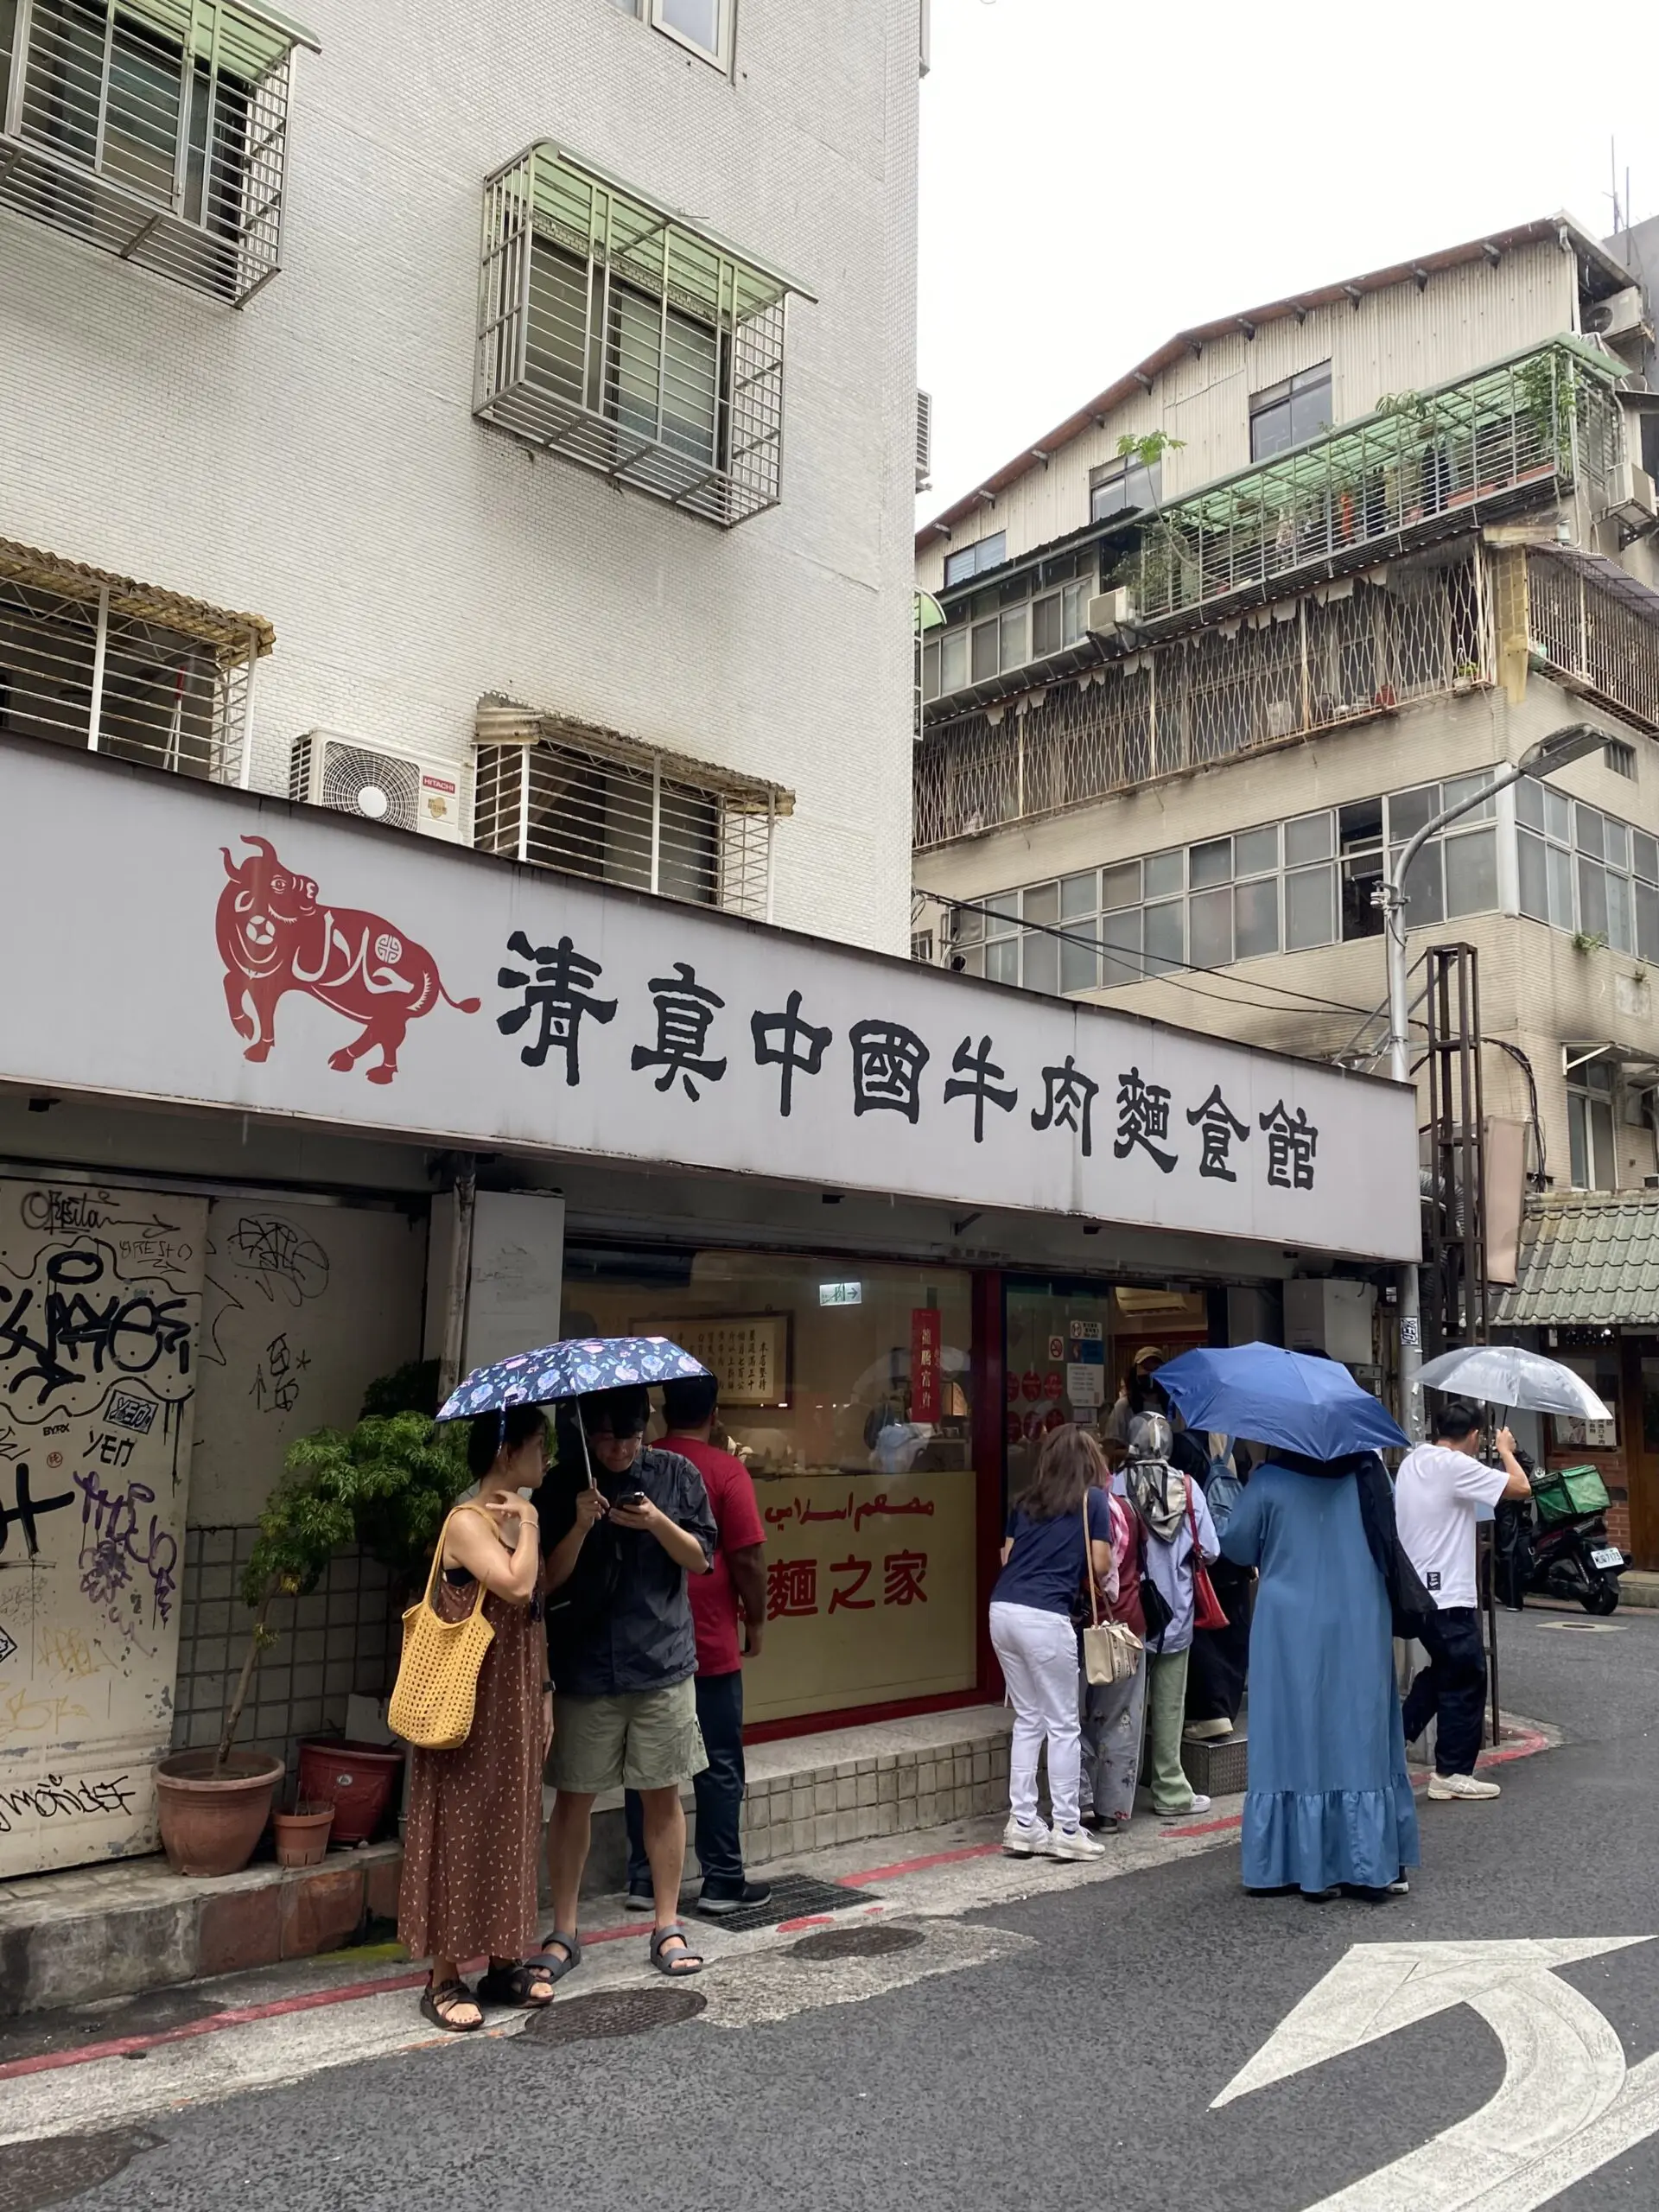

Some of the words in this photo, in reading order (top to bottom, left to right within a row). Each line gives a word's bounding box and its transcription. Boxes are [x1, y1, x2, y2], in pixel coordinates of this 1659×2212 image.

[424, 777, 454, 792] HITACHI
[291, 910, 415, 994] حلال
[496, 931, 1319, 1191] 清真中國牛肉麵食館
[735, 1548, 928, 1622] 麵之家
